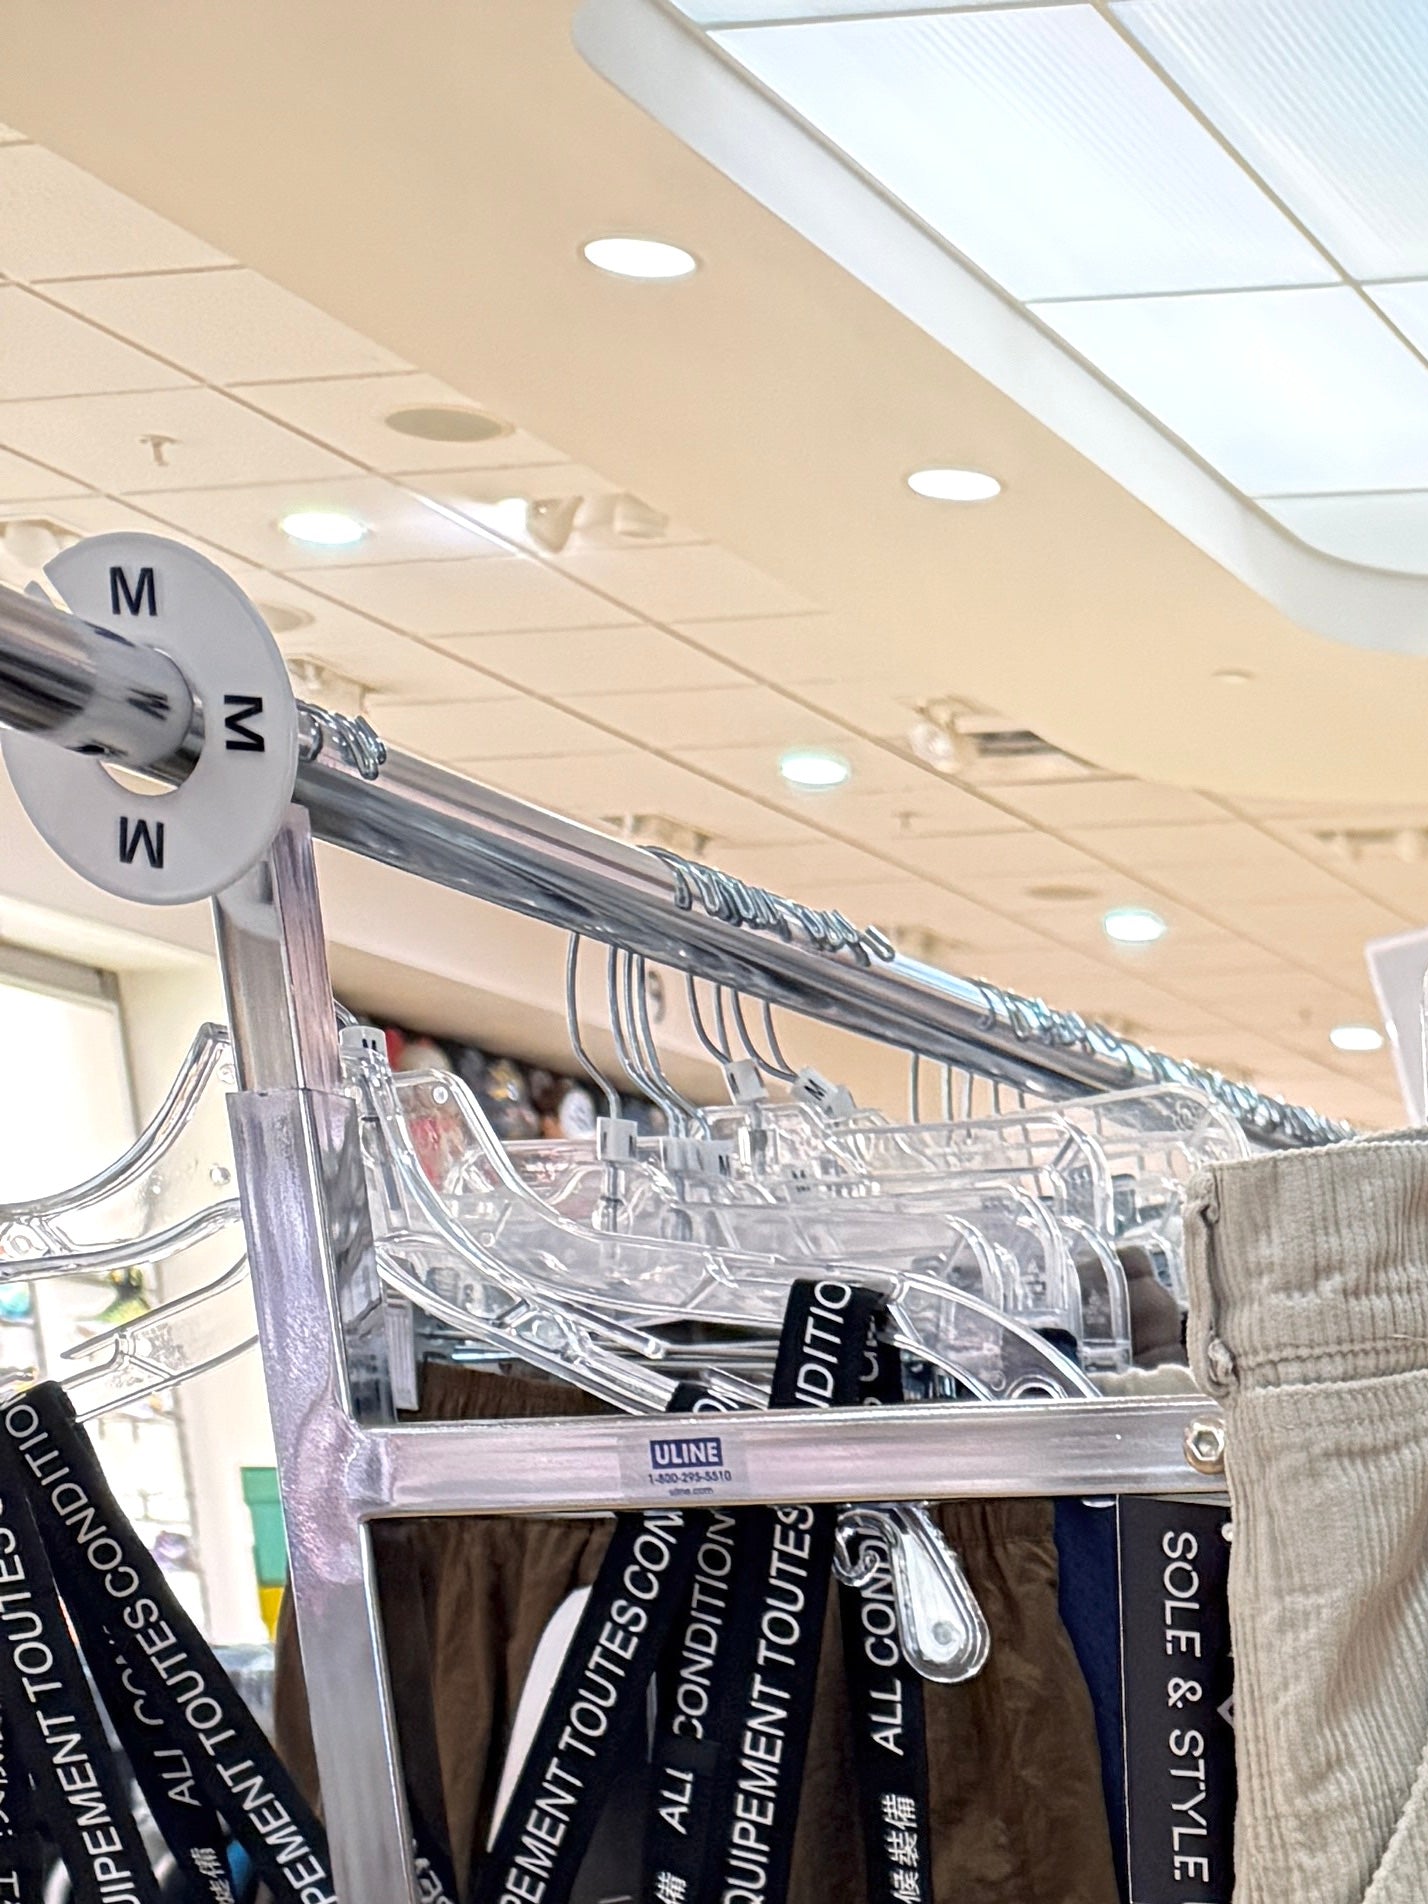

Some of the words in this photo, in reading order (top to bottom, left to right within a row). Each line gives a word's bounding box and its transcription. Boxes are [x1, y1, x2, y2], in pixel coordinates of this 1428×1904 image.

[109, 566, 158, 617] M
[223, 694, 266, 753] M
[119, 815, 165, 870] M
[653, 1441, 720, 1466] ULINE
[756, 1502, 815, 1667] TOUTES
[1161, 1530, 1202, 1659] SOLE
[123, 1597, 237, 1757] TOUTES
[558, 1600, 648, 1759] TOUTES
[1166, 1676, 1203, 1711] &
[870, 1678, 904, 1756] ALL
[1168, 1728, 1211, 1884] STYLE
